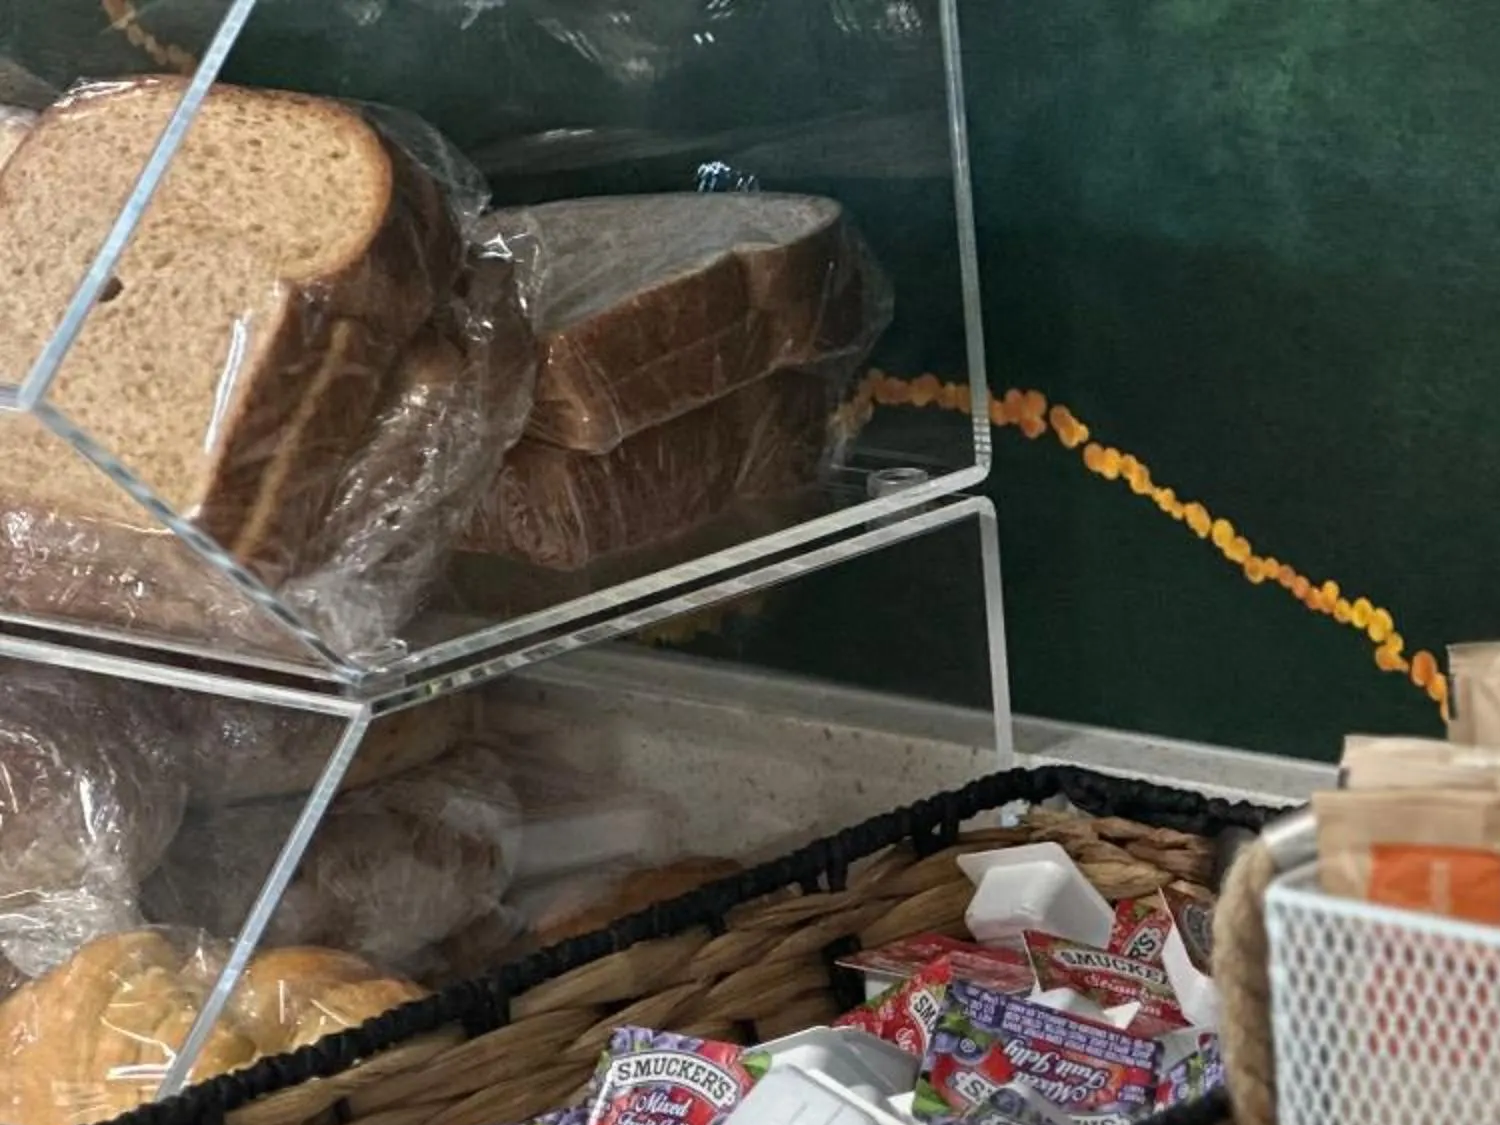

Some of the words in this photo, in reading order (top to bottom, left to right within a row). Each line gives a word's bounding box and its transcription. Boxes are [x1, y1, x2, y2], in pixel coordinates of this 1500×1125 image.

[1003, 1039, 1060, 1073] Jelly
[617, 1054, 732, 1101] SMUCKER'S
[1055, 1059, 1110, 1089] Fruit
[631, 1090, 690, 1119] Mixed
